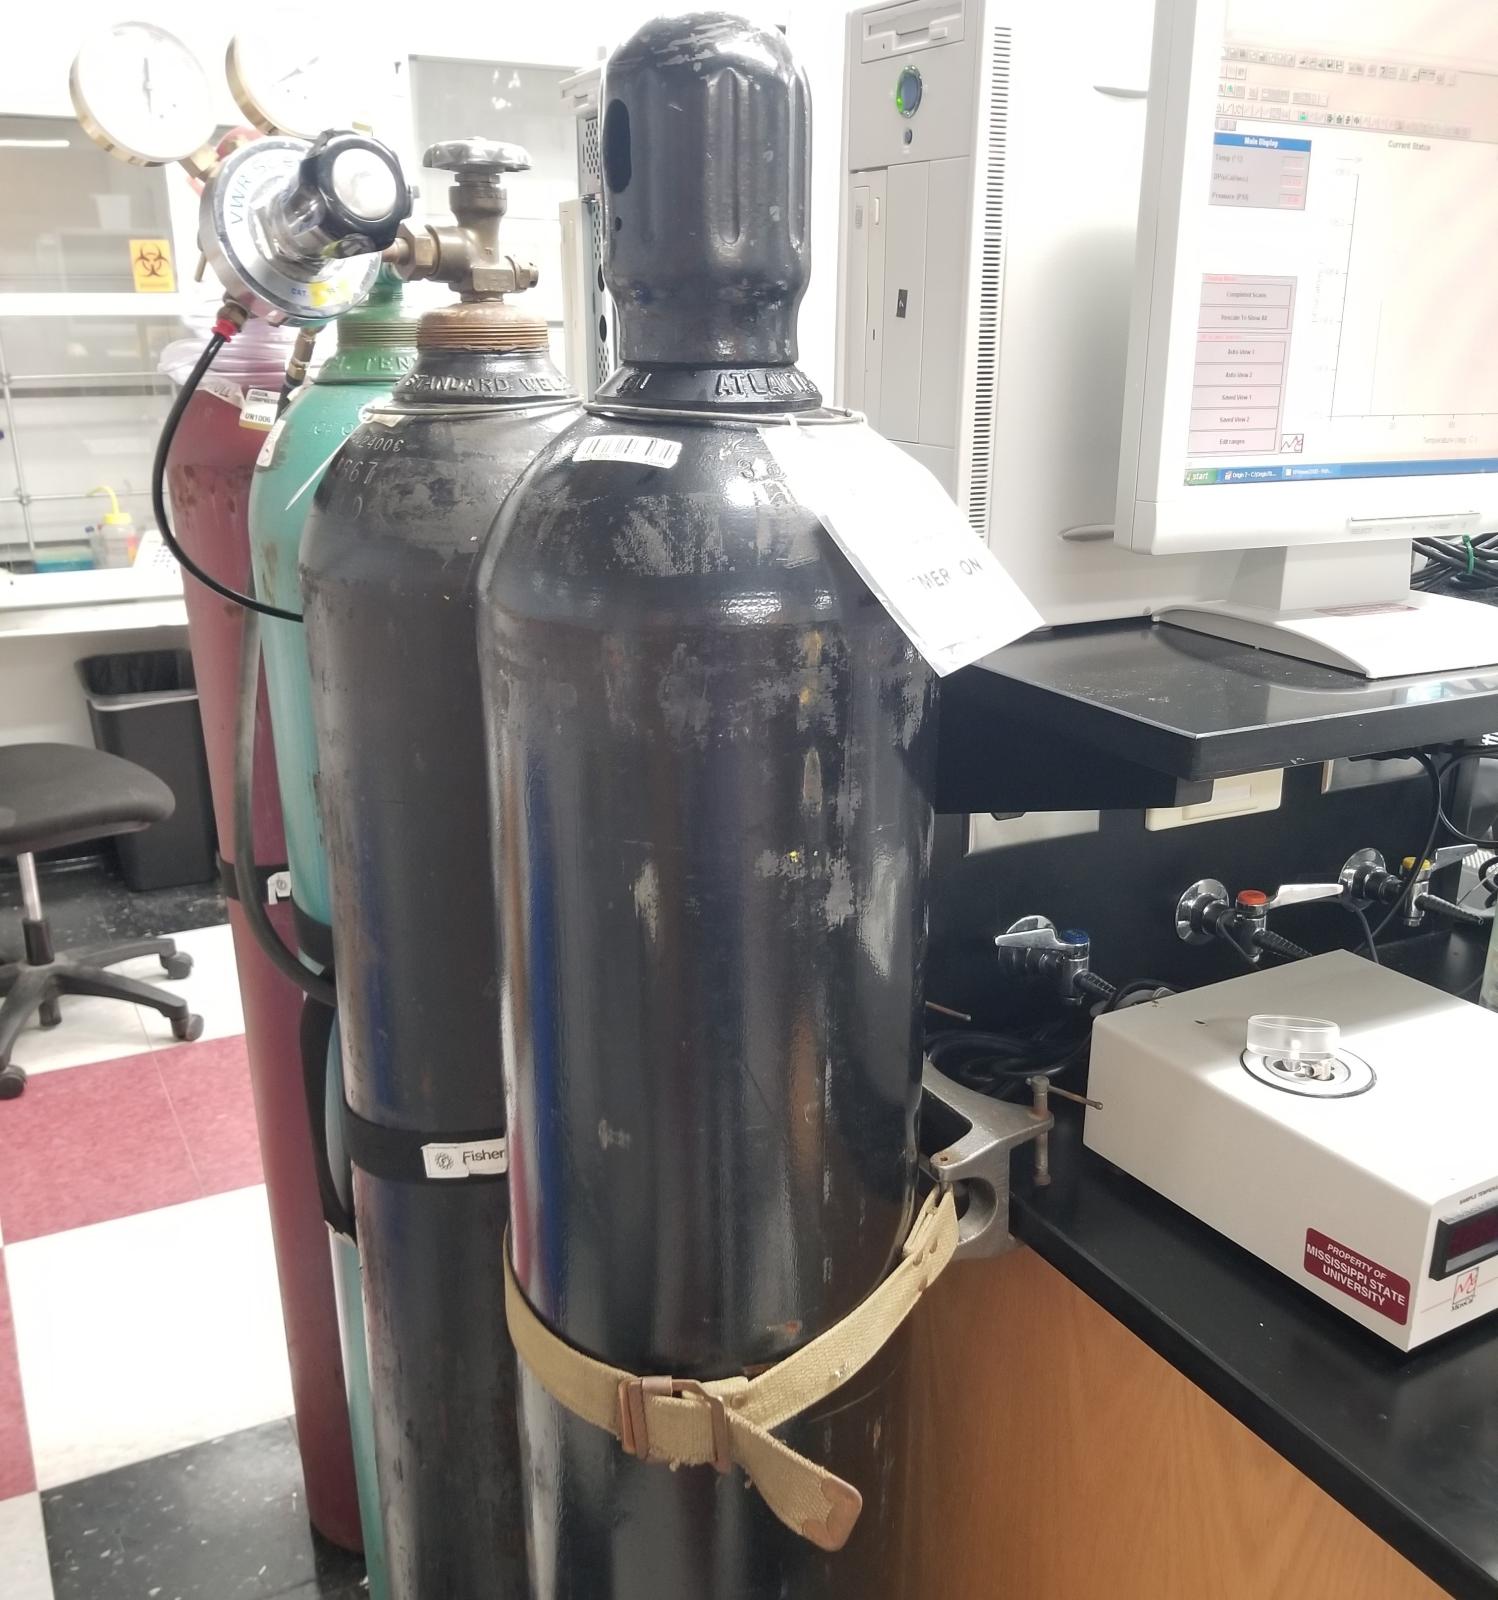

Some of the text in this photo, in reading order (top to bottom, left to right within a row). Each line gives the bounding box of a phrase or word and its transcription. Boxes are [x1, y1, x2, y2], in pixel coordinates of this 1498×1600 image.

[230, 175, 252, 224] VWR
[1193, 471, 1208, 480] start
[959, 558, 983, 576] ON
[462, 1149, 505, 1165] Fisher
[1306, 1243, 1406, 1306] MISSISSIPPI STATE
[1327, 1243, 1388, 1281] PROPERTY OF
[1322, 1265, 1386, 1306] UNIVERSITY
